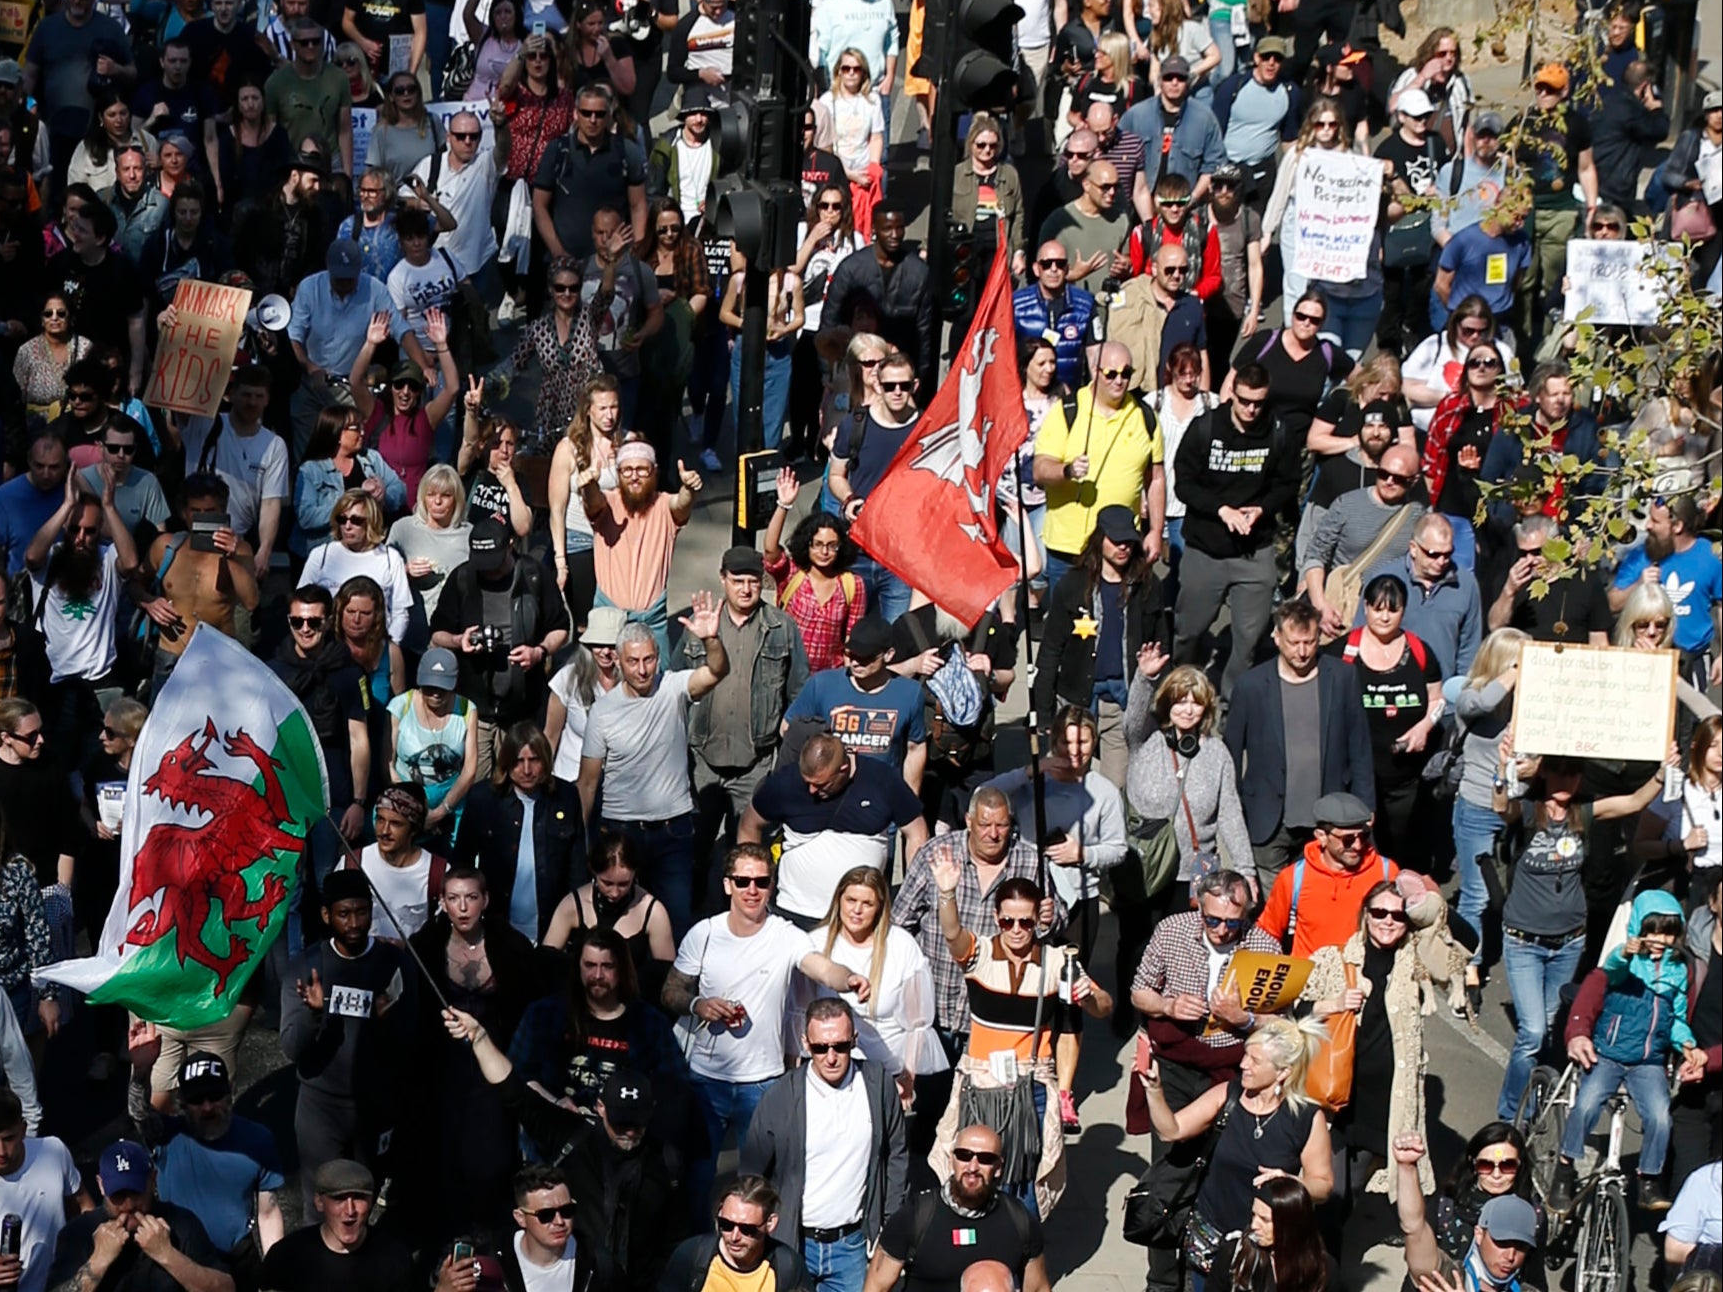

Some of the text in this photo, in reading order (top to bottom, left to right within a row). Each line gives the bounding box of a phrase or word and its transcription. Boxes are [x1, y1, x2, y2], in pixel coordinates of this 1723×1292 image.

[1304, 165, 1373, 189] No vaccine
[704, 247, 731, 257] LOVE
[1312, 262, 1351, 278] RIGHTS
[174, 282, 242, 324] UNMASK
[167, 321, 222, 351] THE
[835, 712, 860, 732] 5G
[1575, 740, 1601, 753] BBC
[1260, 963, 1291, 1009] ENOUG
[185, 1061, 221, 1081] UFC
[116, 1154, 131, 1172] LA
